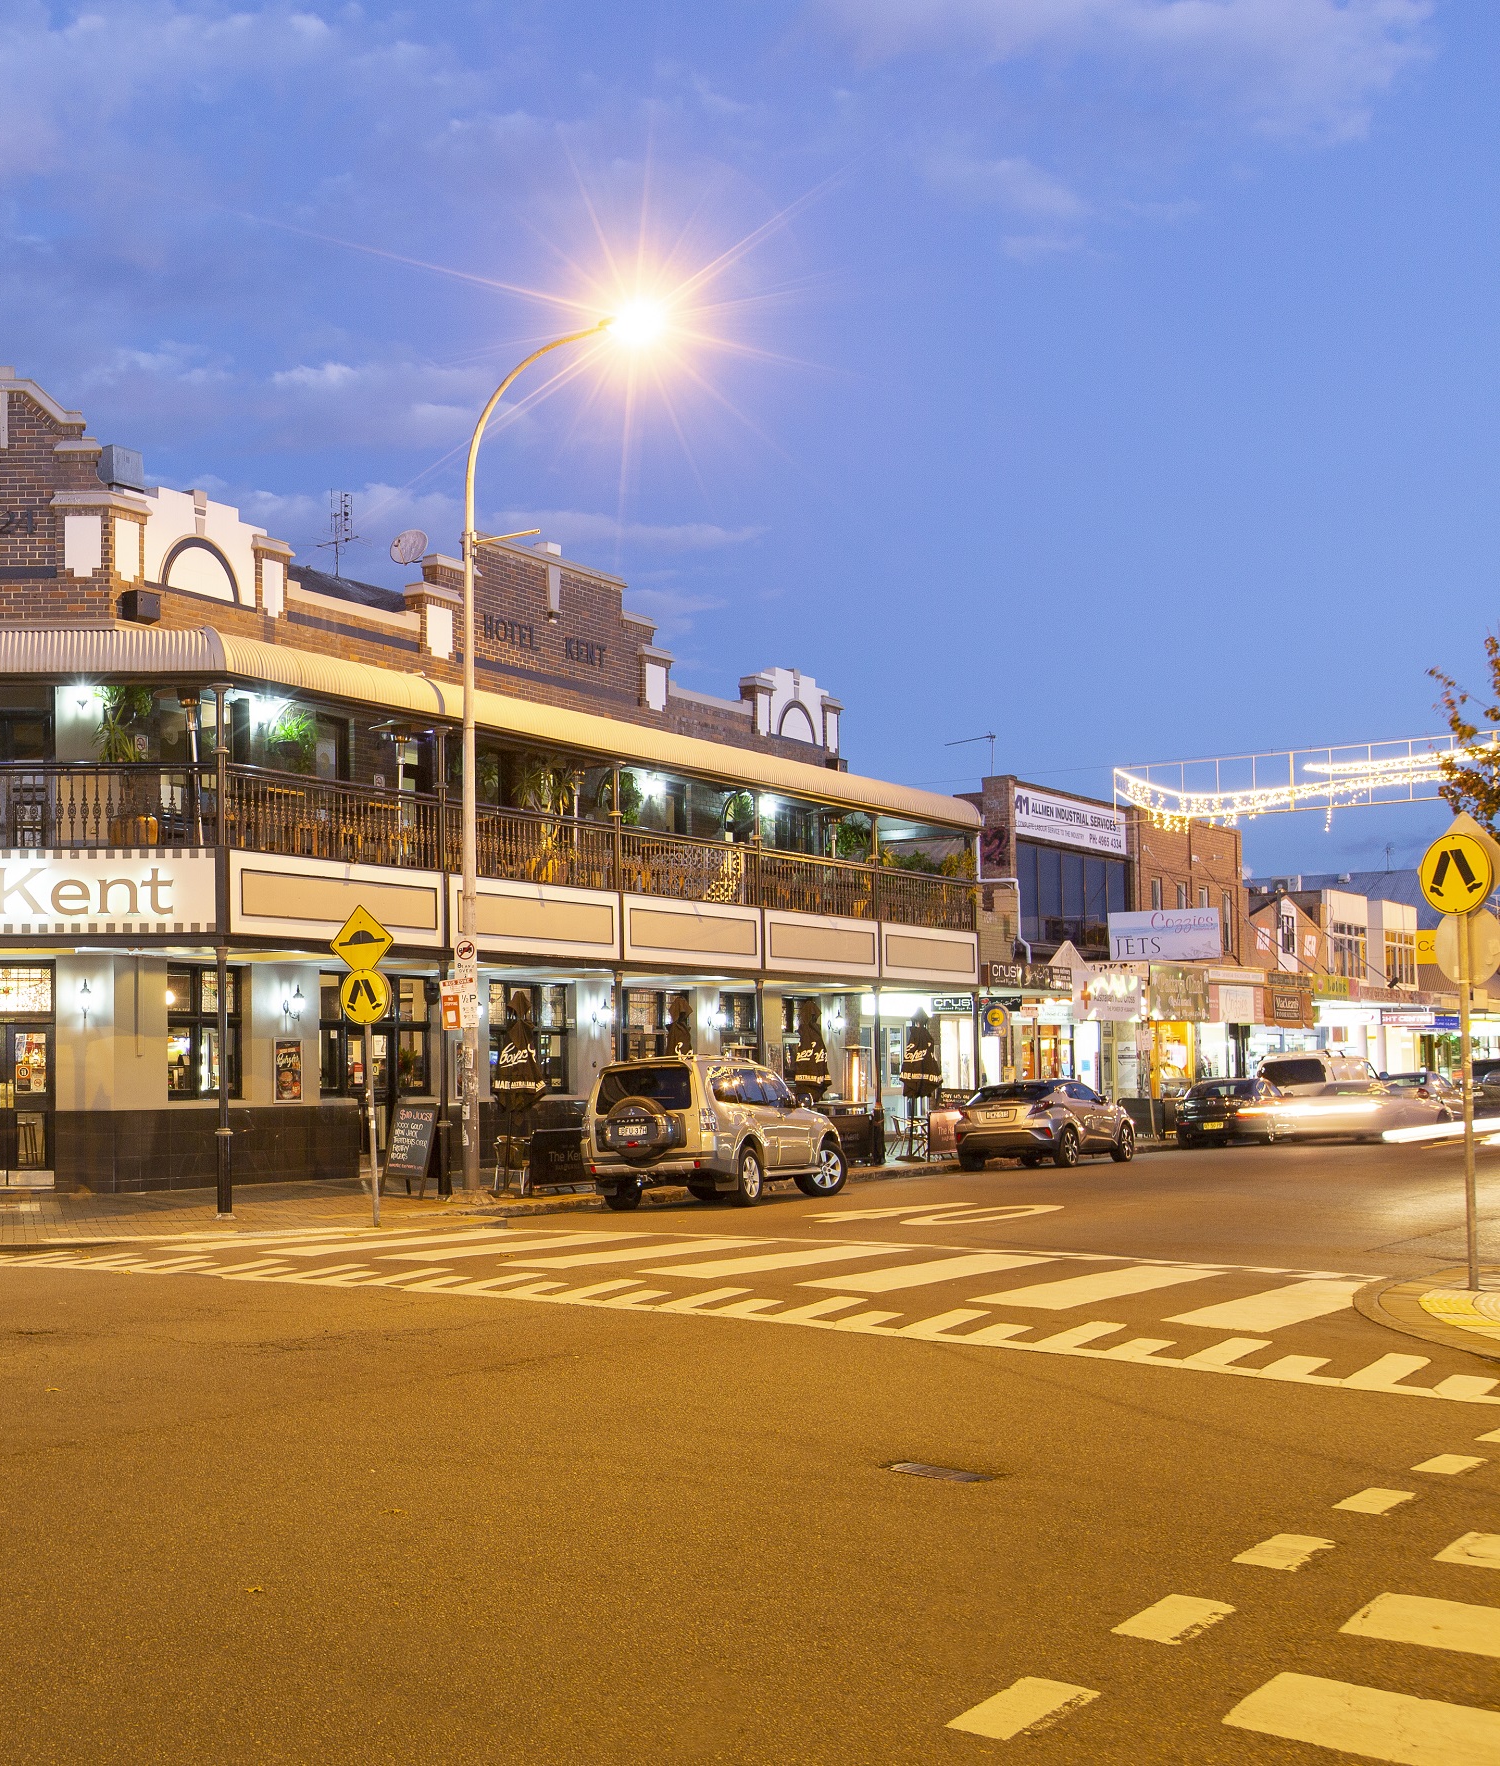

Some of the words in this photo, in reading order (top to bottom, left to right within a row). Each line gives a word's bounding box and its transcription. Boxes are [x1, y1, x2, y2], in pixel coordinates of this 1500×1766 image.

[484, 613, 540, 651] HOTEL
[565, 636, 607, 668] KENT
[1031, 802, 1055, 818] ALLMEN
[1055, 807, 1089, 827] INDUSTRIAL
[1090, 813, 1116, 832] SERVICES
[1047, 826, 1060, 835] SERVICE
[1098, 835, 1110, 848] 4965
[1110, 838, 1122, 849] 4334
[1151, 912, 1213, 934] Cozzies
[1116, 936, 1161, 959] JETS
[992, 963, 1021, 978] crust
[410, 1122, 424, 1131] GOLD
[549, 1151, 565, 1162] The
[802, 1202, 1065, 1226] 40
